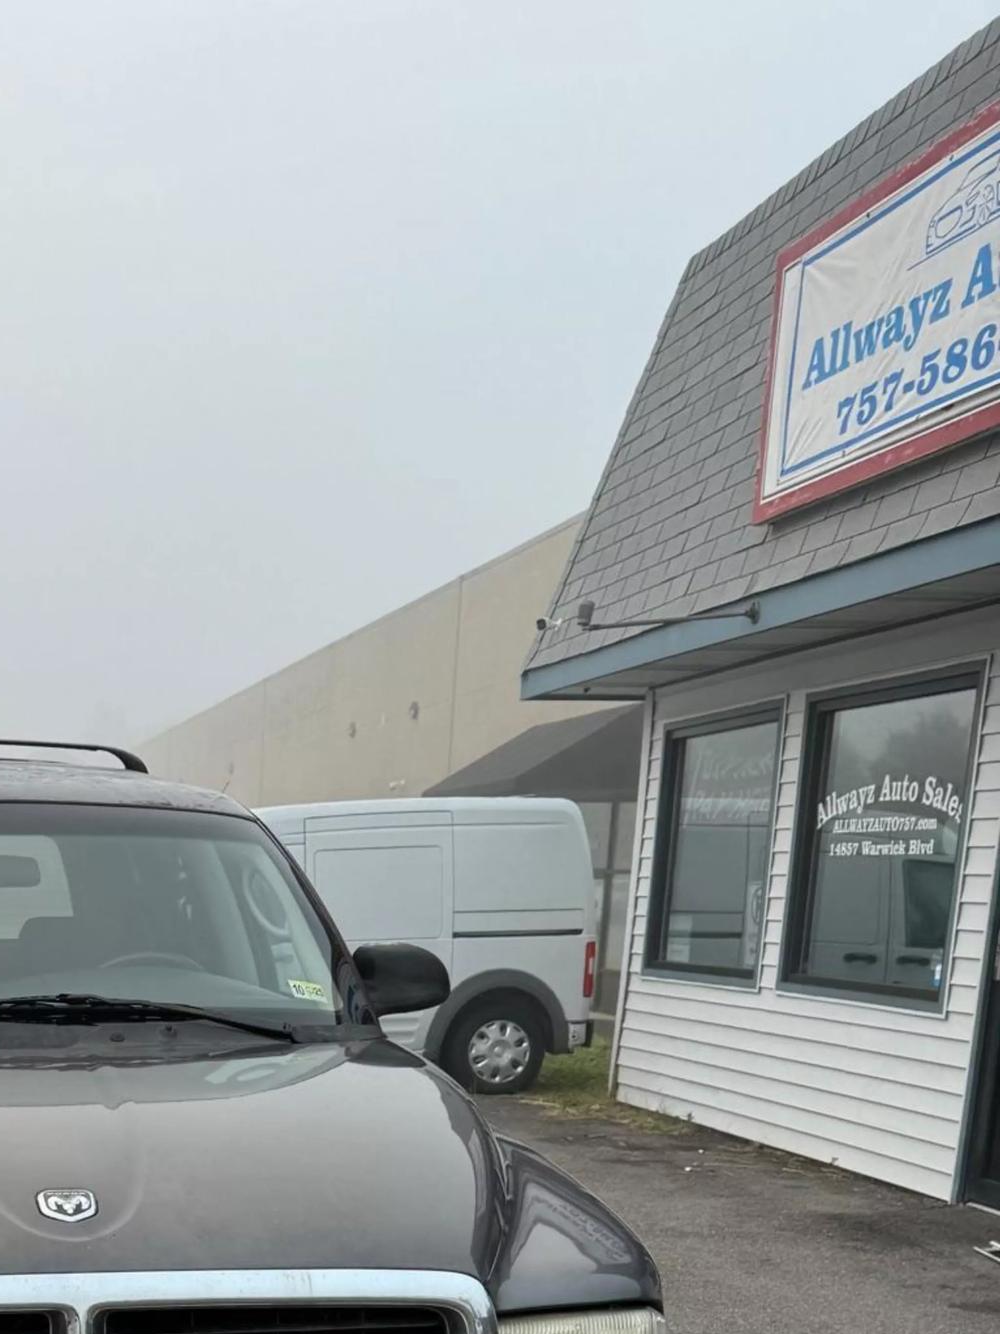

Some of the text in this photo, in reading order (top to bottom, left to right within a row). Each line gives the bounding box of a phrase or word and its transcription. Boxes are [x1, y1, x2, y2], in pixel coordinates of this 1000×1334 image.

[802, 242, 1000, 391] Allwayz A
[816, 784, 876, 830] Allwayz
[879, 773, 919, 802] Auto
[861, 840, 905, 856] Warwick
[907, 838, 934, 855] Blvd
